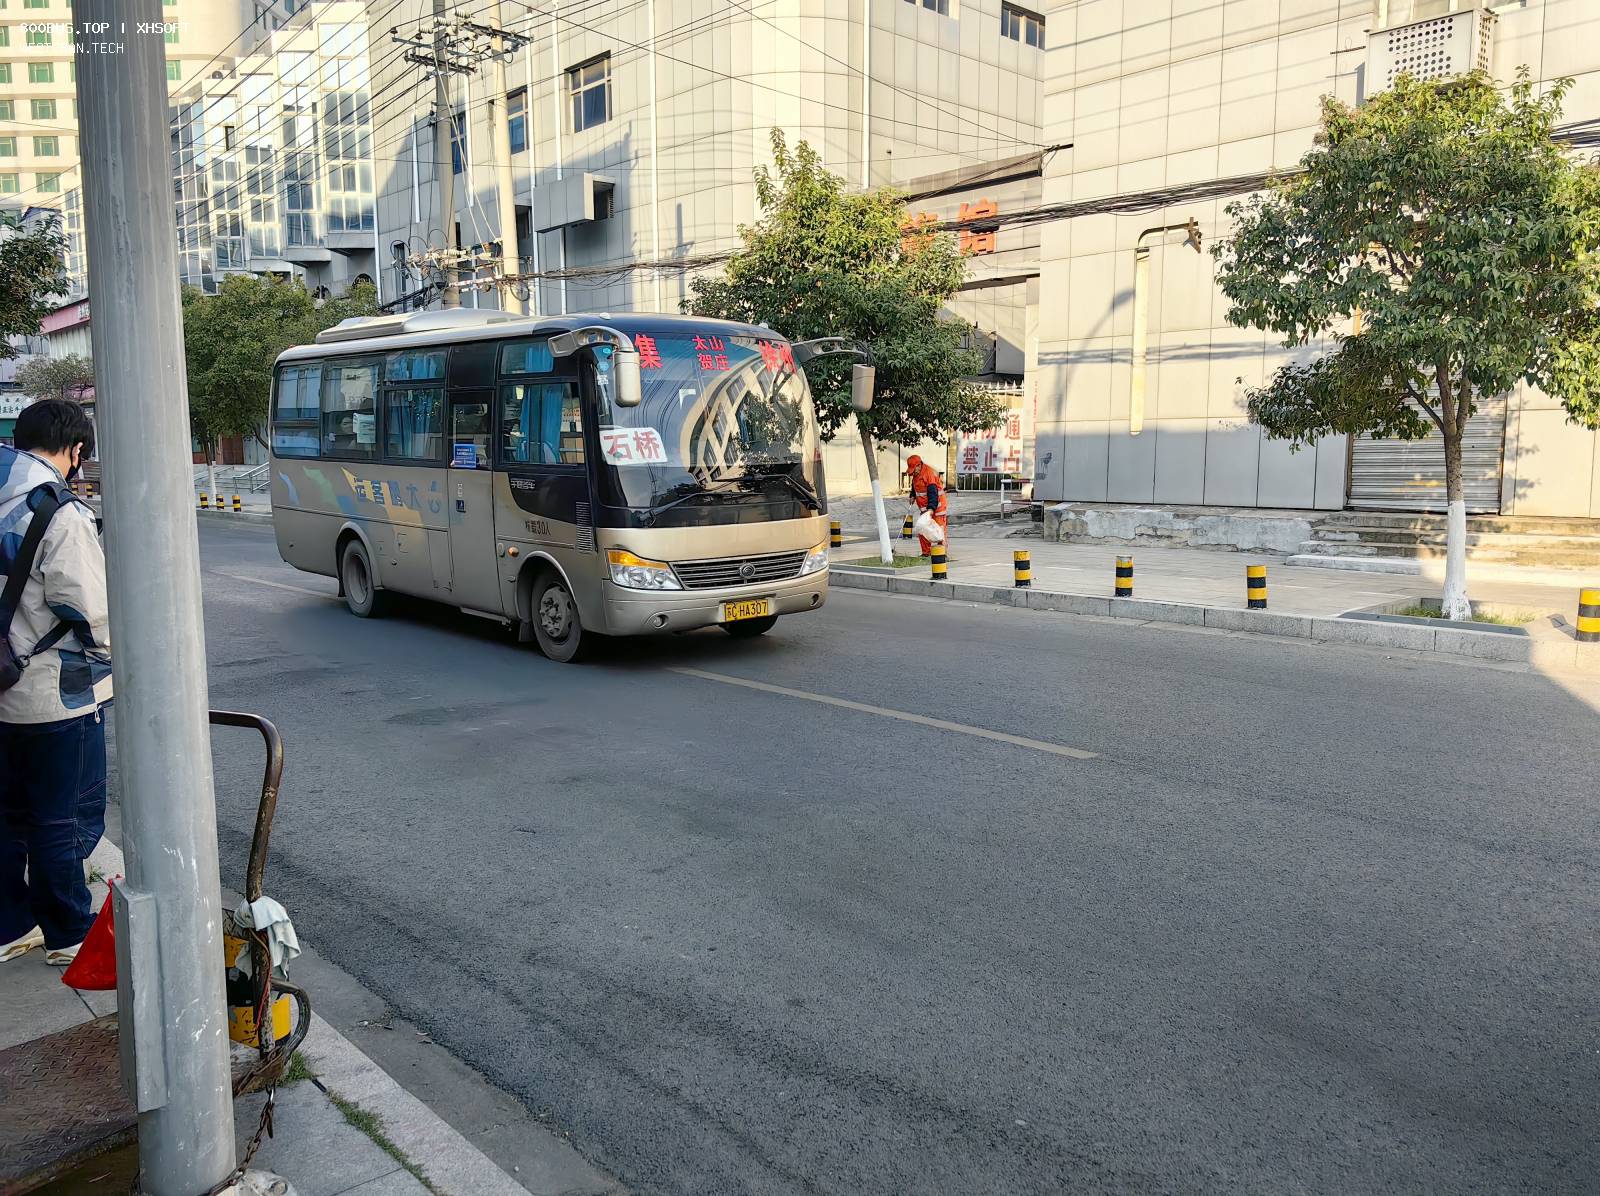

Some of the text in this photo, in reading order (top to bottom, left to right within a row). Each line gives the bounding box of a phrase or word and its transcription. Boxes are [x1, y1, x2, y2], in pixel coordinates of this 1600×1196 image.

[603, 430, 660, 460] 石桥
[962, 445, 1021, 472] 禁止占
